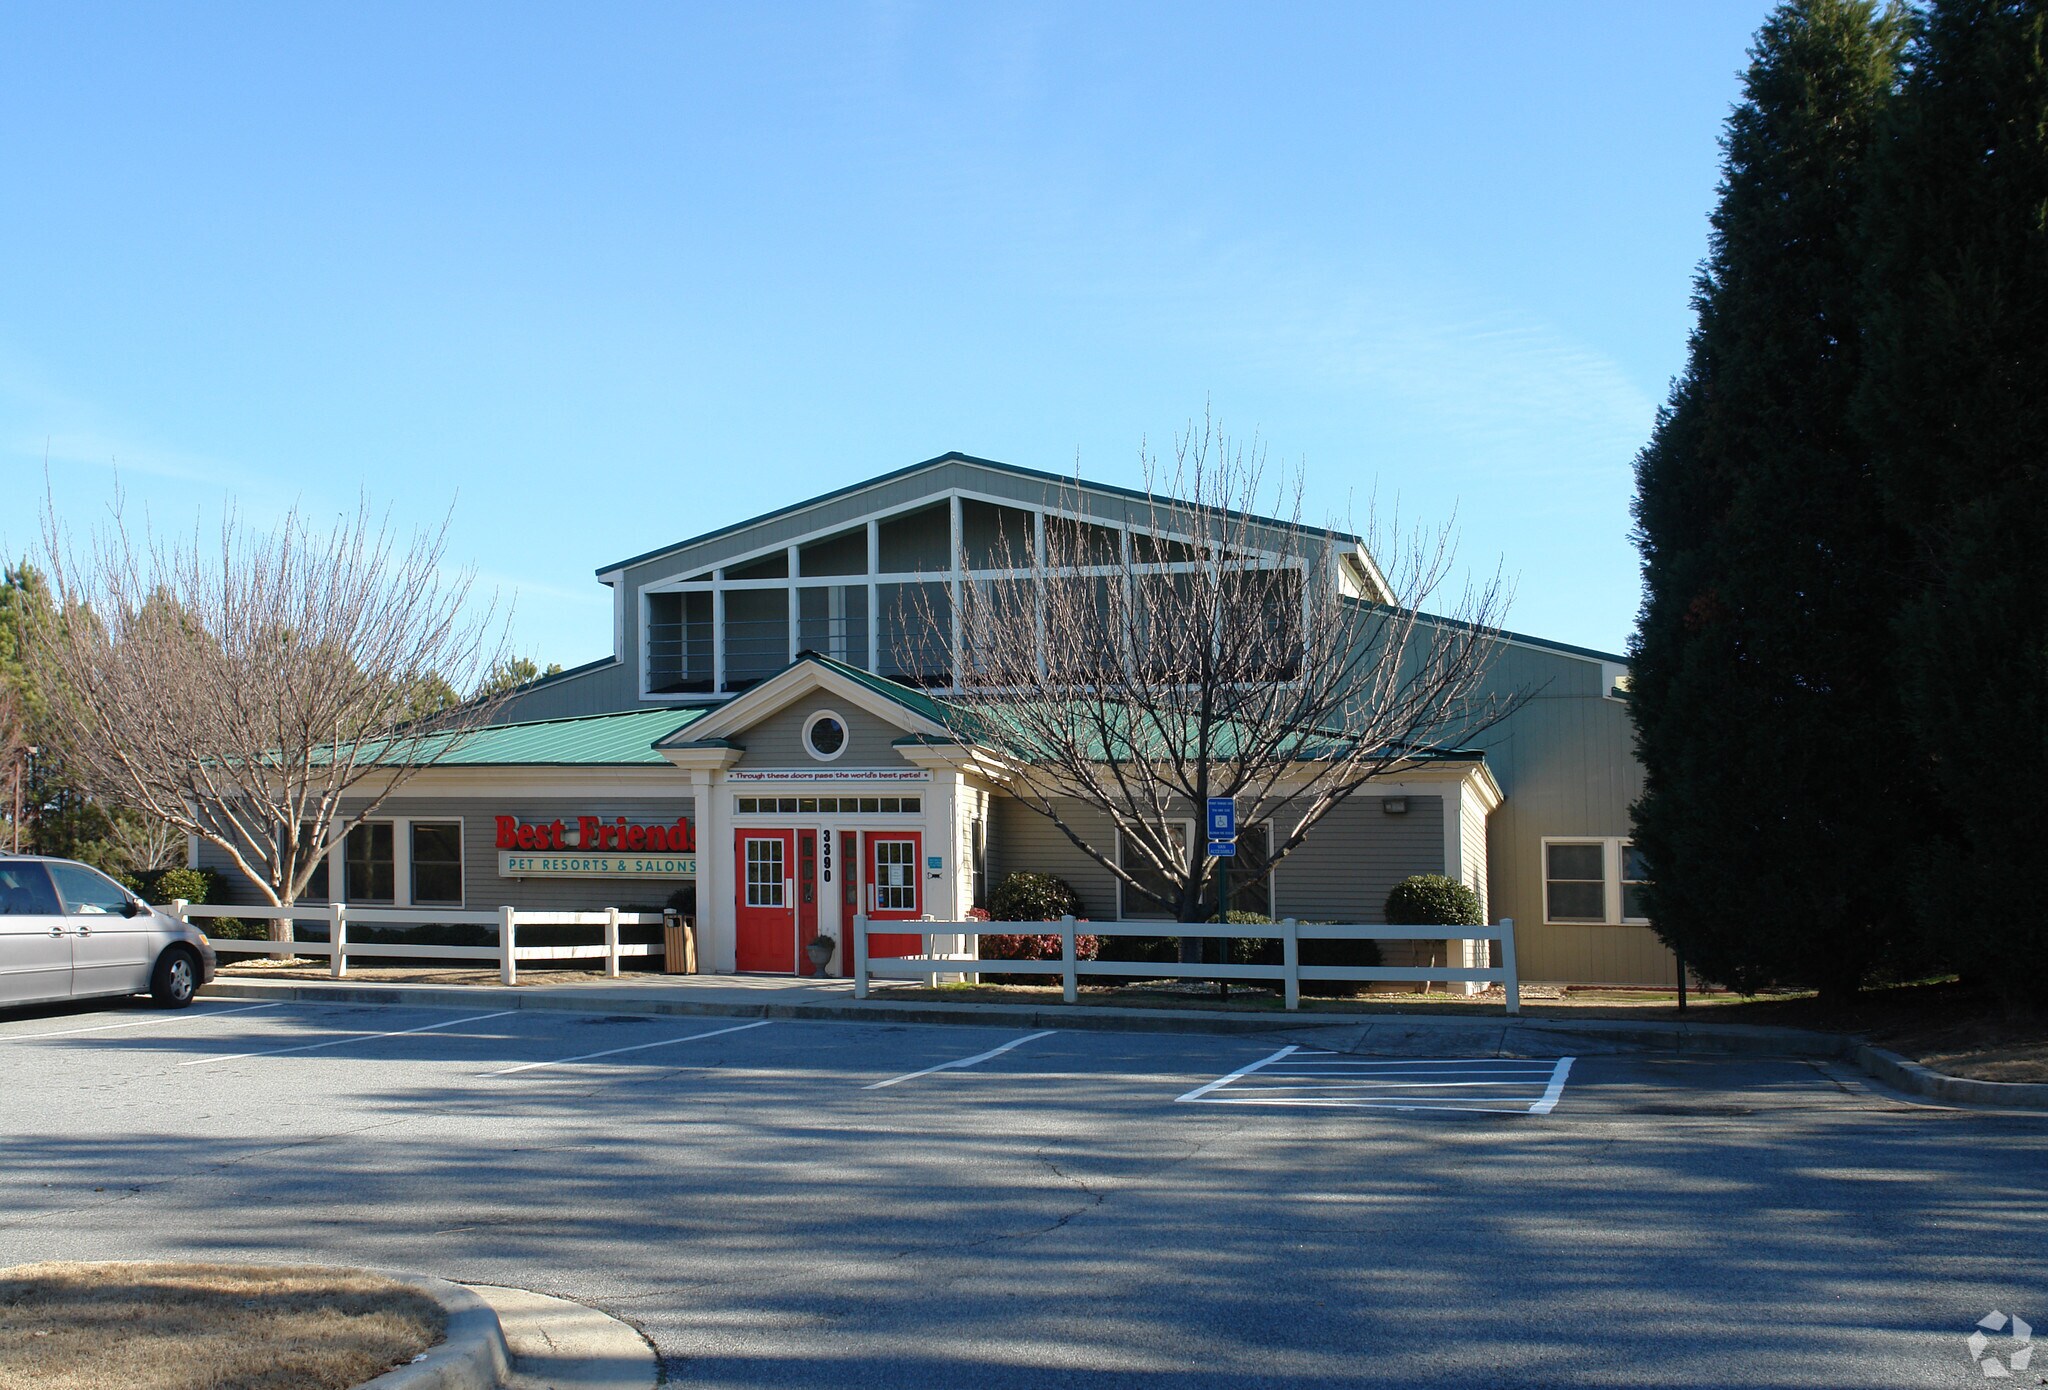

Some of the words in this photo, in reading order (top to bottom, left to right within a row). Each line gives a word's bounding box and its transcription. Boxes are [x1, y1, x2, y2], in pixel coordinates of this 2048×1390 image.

[736, 772, 765, 780] Through
[814, 773, 833, 781] pass
[495, 815, 566, 849] Best
[509, 858, 533, 869] PET
[542, 859, 608, 871] RESORTS
[618, 861, 627, 871] &
[636, 860, 696, 872] SALONS
[823, 829, 831, 882] 3390
